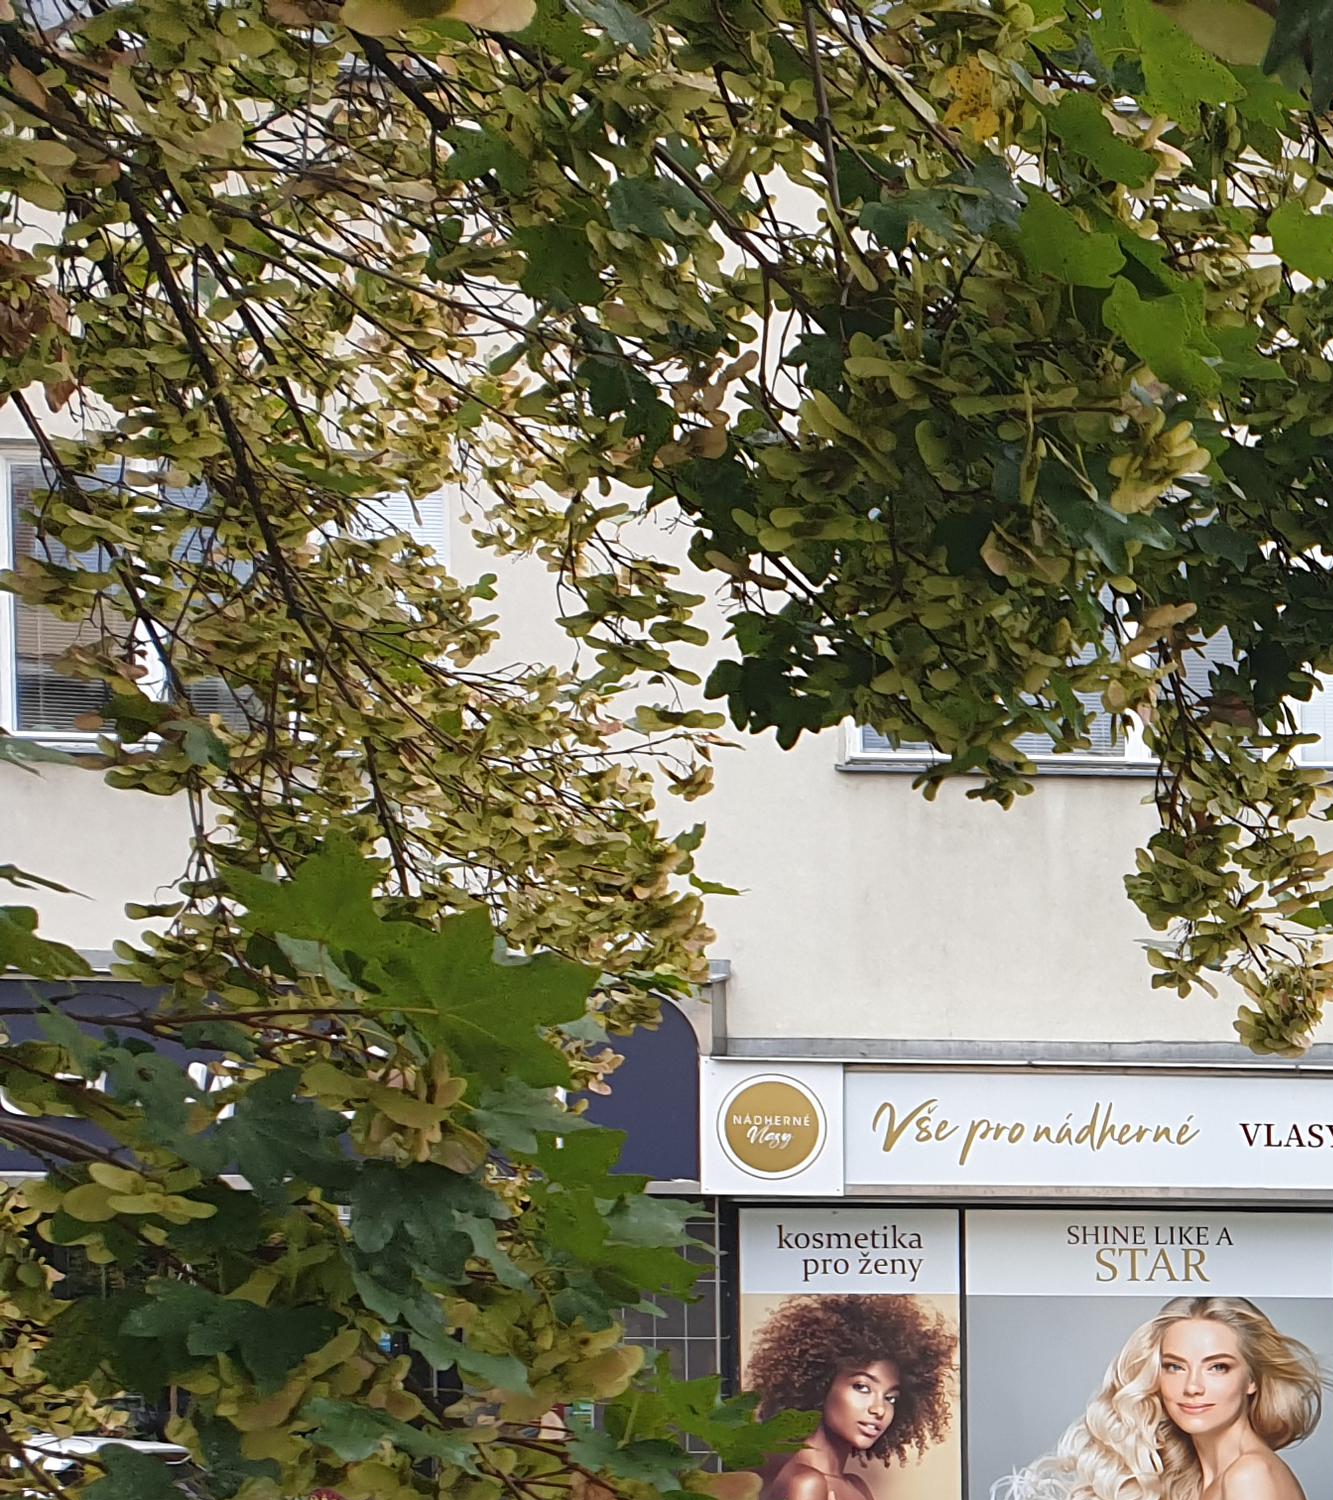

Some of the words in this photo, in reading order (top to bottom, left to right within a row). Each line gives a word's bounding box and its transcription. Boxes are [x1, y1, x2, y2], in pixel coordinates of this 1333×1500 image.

[733, 1112, 811, 1127] NÁDHERNÉ
[872, 1099, 960, 1152] Vše
[958, 1116, 1024, 1166] pro
[1033, 1102, 1201, 1151] nádherné
[777, 1224, 924, 1250] kosmetika
[1067, 1225, 1146, 1245] SHINE
[1154, 1226, 1209, 1246] LIKE
[1215, 1227, 1234, 1246] A
[802, 1256, 850, 1281] pro
[858, 1251, 924, 1282] ženy
[1095, 1247, 1211, 1282] STAR
